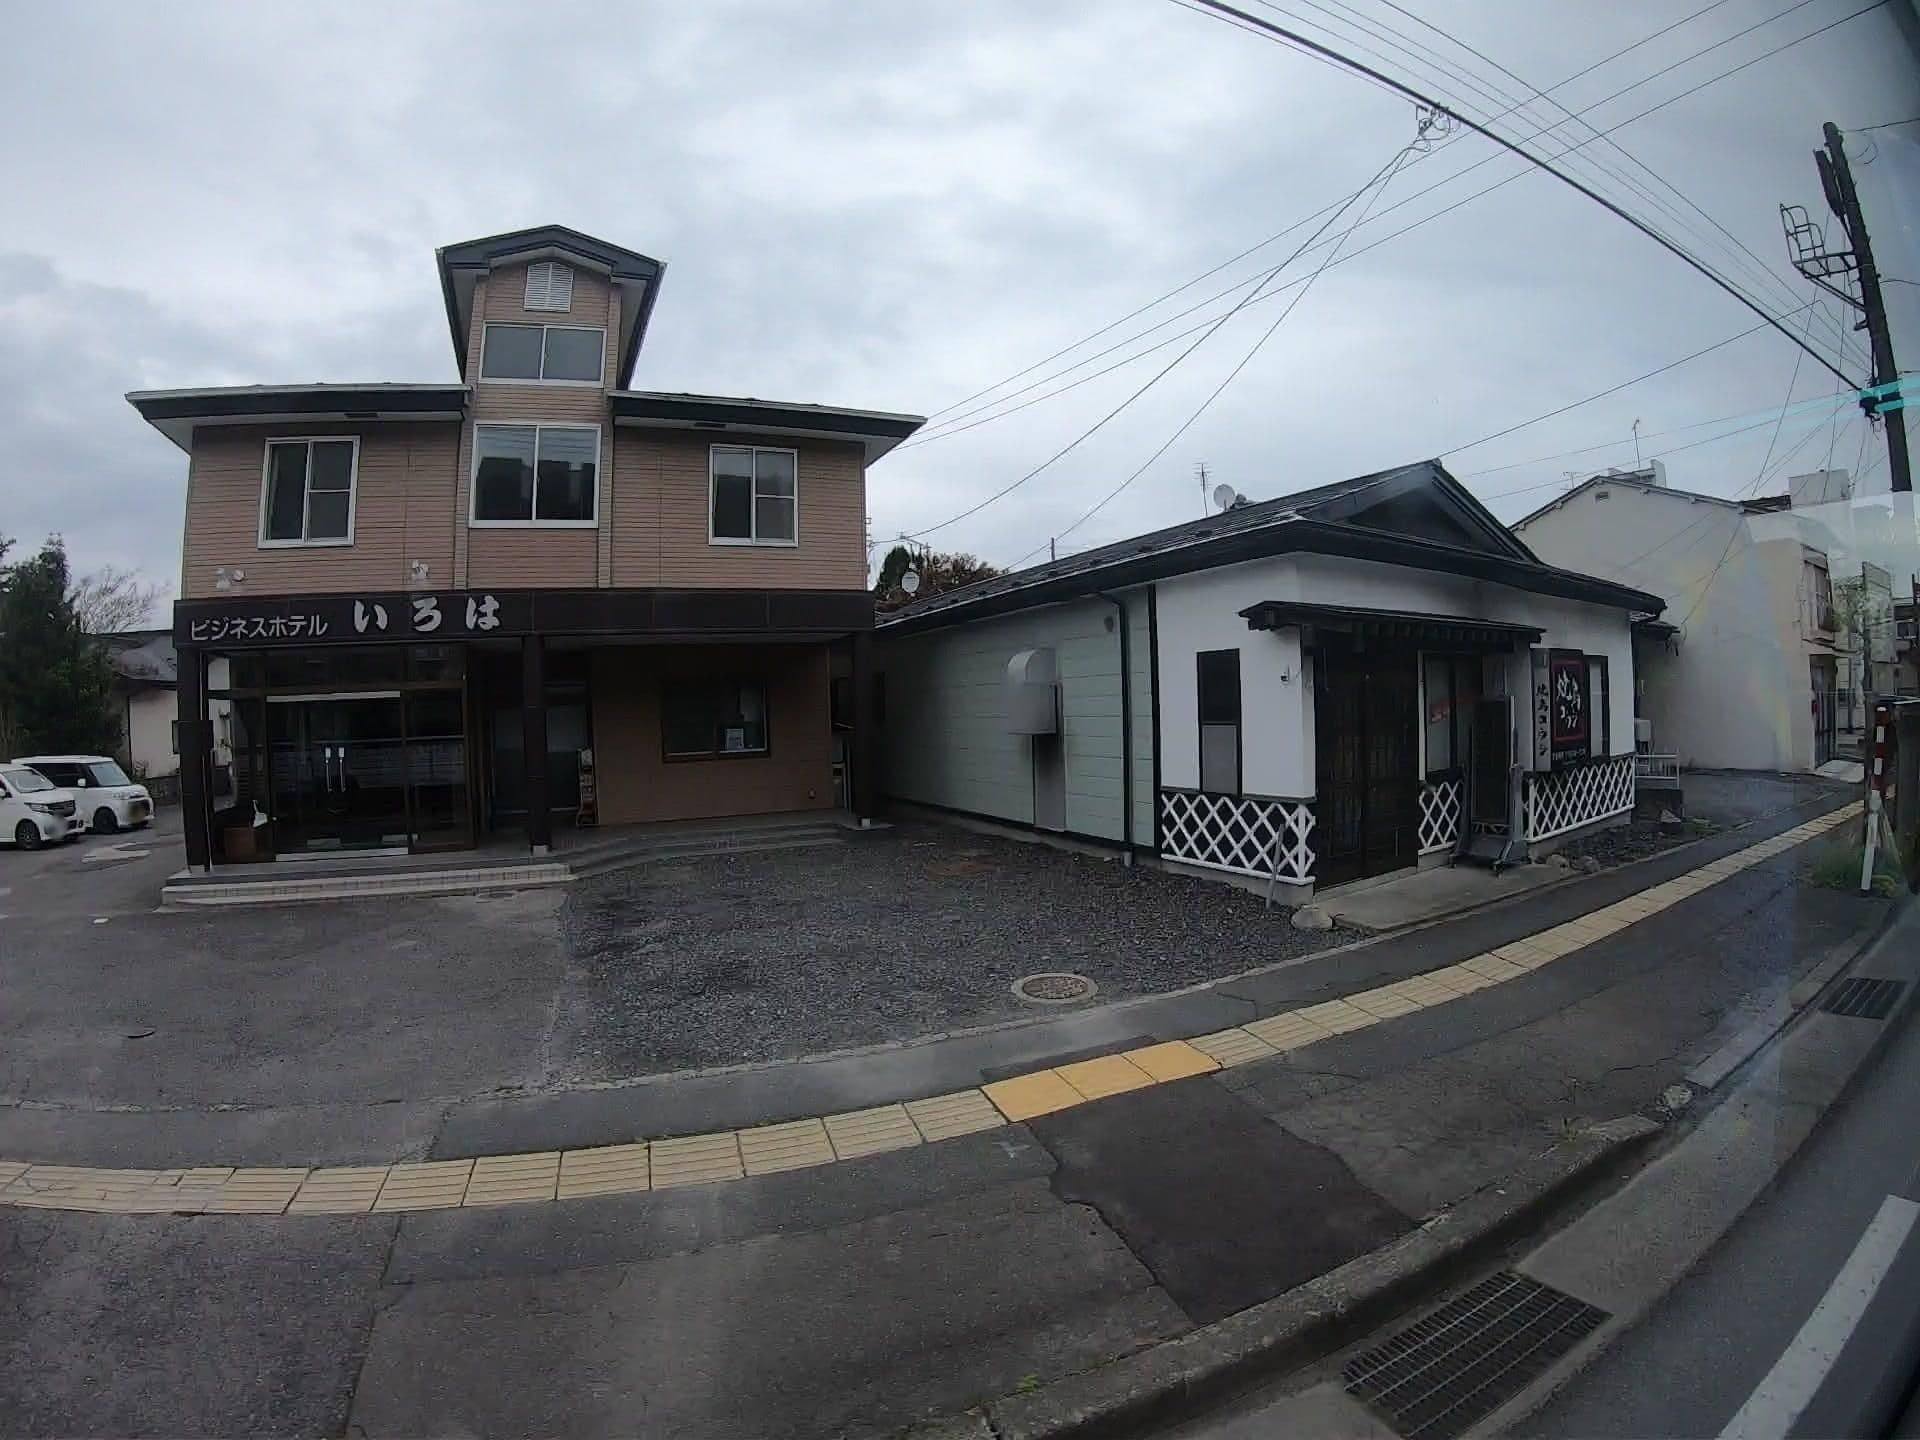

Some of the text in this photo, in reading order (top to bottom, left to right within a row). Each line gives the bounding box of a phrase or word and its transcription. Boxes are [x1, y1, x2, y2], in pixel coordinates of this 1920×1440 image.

[190, 594, 501, 641] ビジネスホテル いろは
